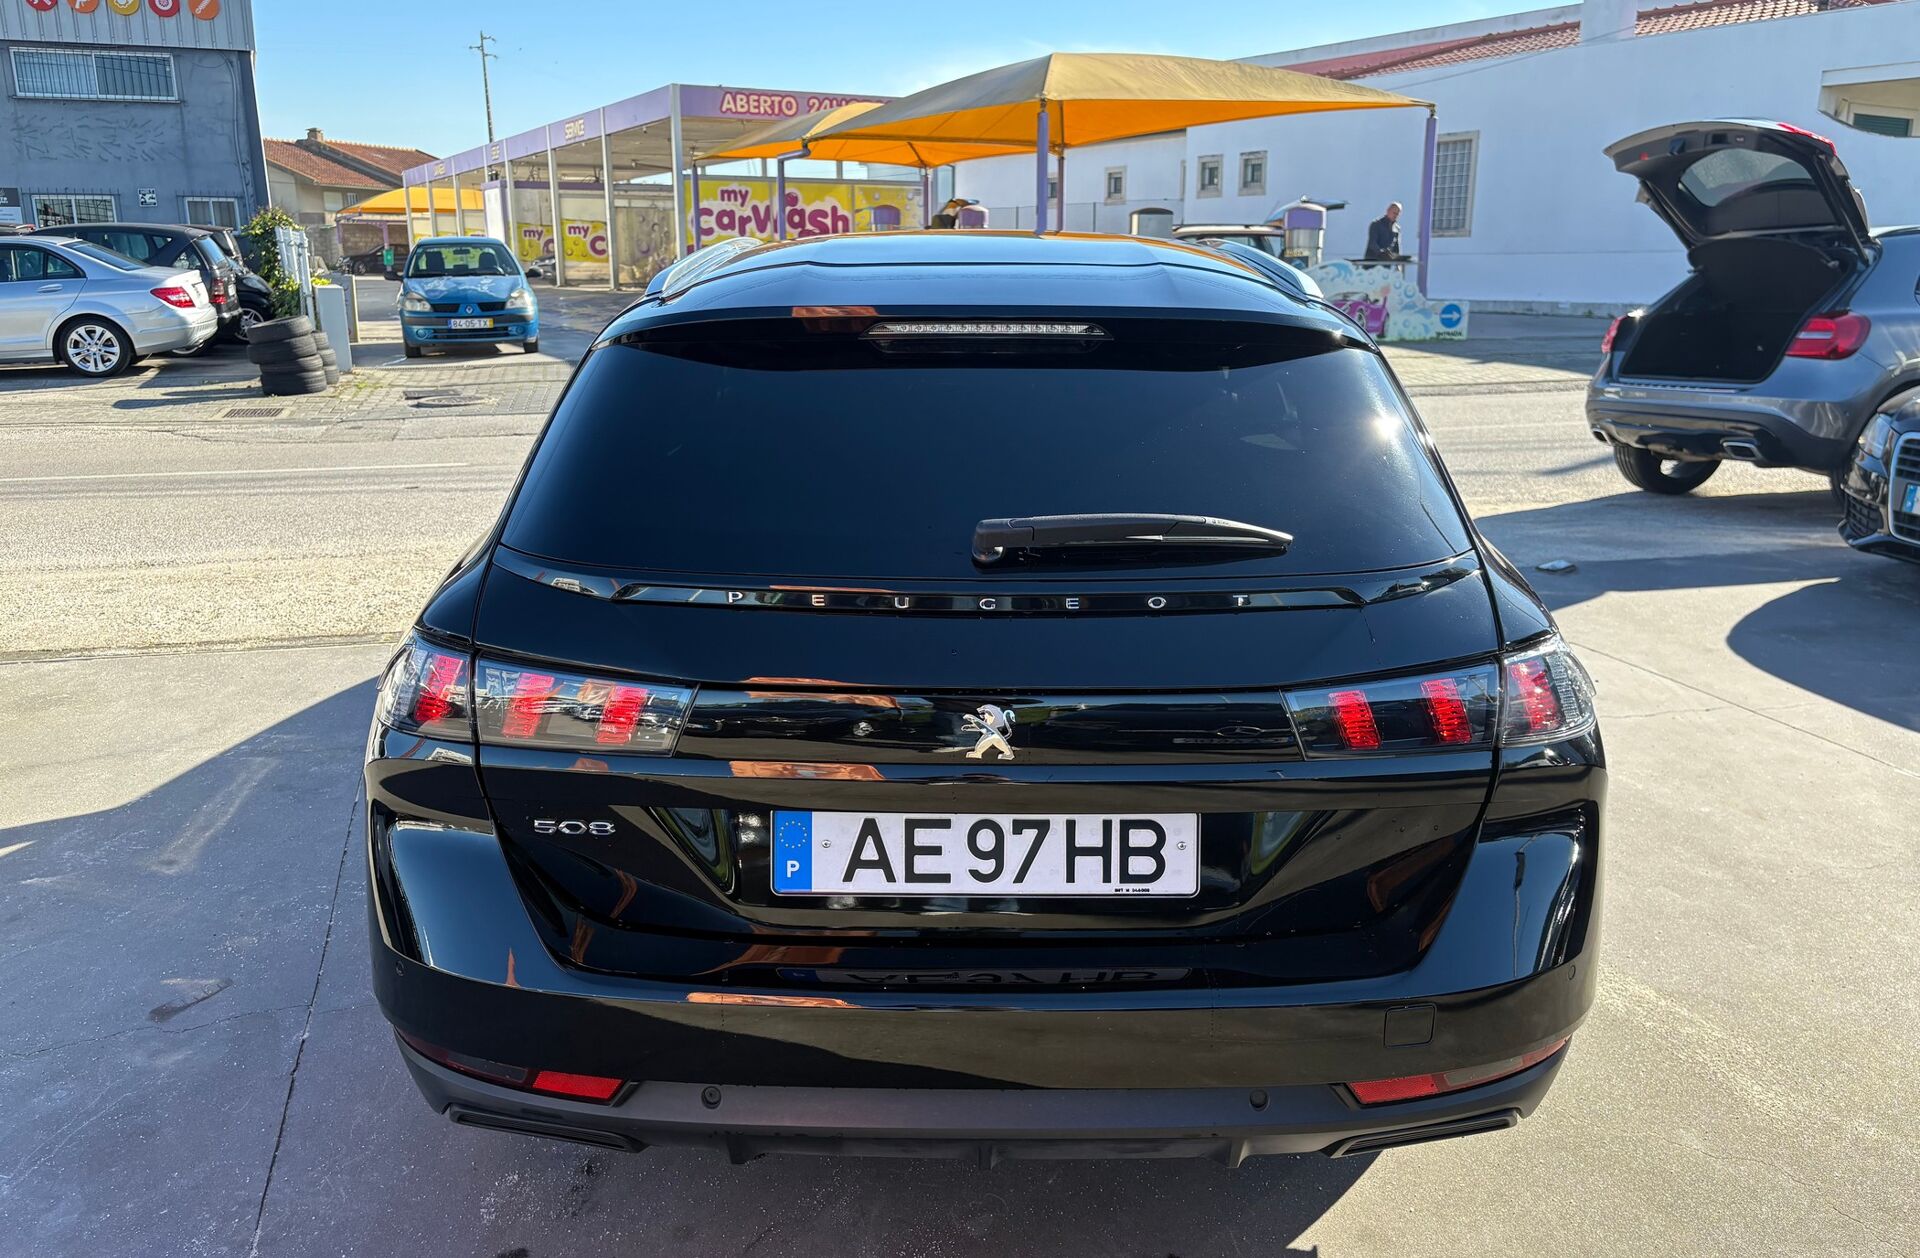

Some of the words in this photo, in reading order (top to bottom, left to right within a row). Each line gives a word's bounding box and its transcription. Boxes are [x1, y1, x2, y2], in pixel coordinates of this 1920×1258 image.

[721, 92, 799, 116] ABERTO
[720, 188, 749, 206] my
[523, 229, 543, 241] my
[567, 225, 590, 239] my
[728, 591, 1249, 611] PEUGEOT
[534, 819, 616, 835] 508
[841, 817, 952, 884] AE
[966, 818, 1051, 884] 97
[1065, 818, 1167, 885] HB
[786, 860, 800, 878] P
